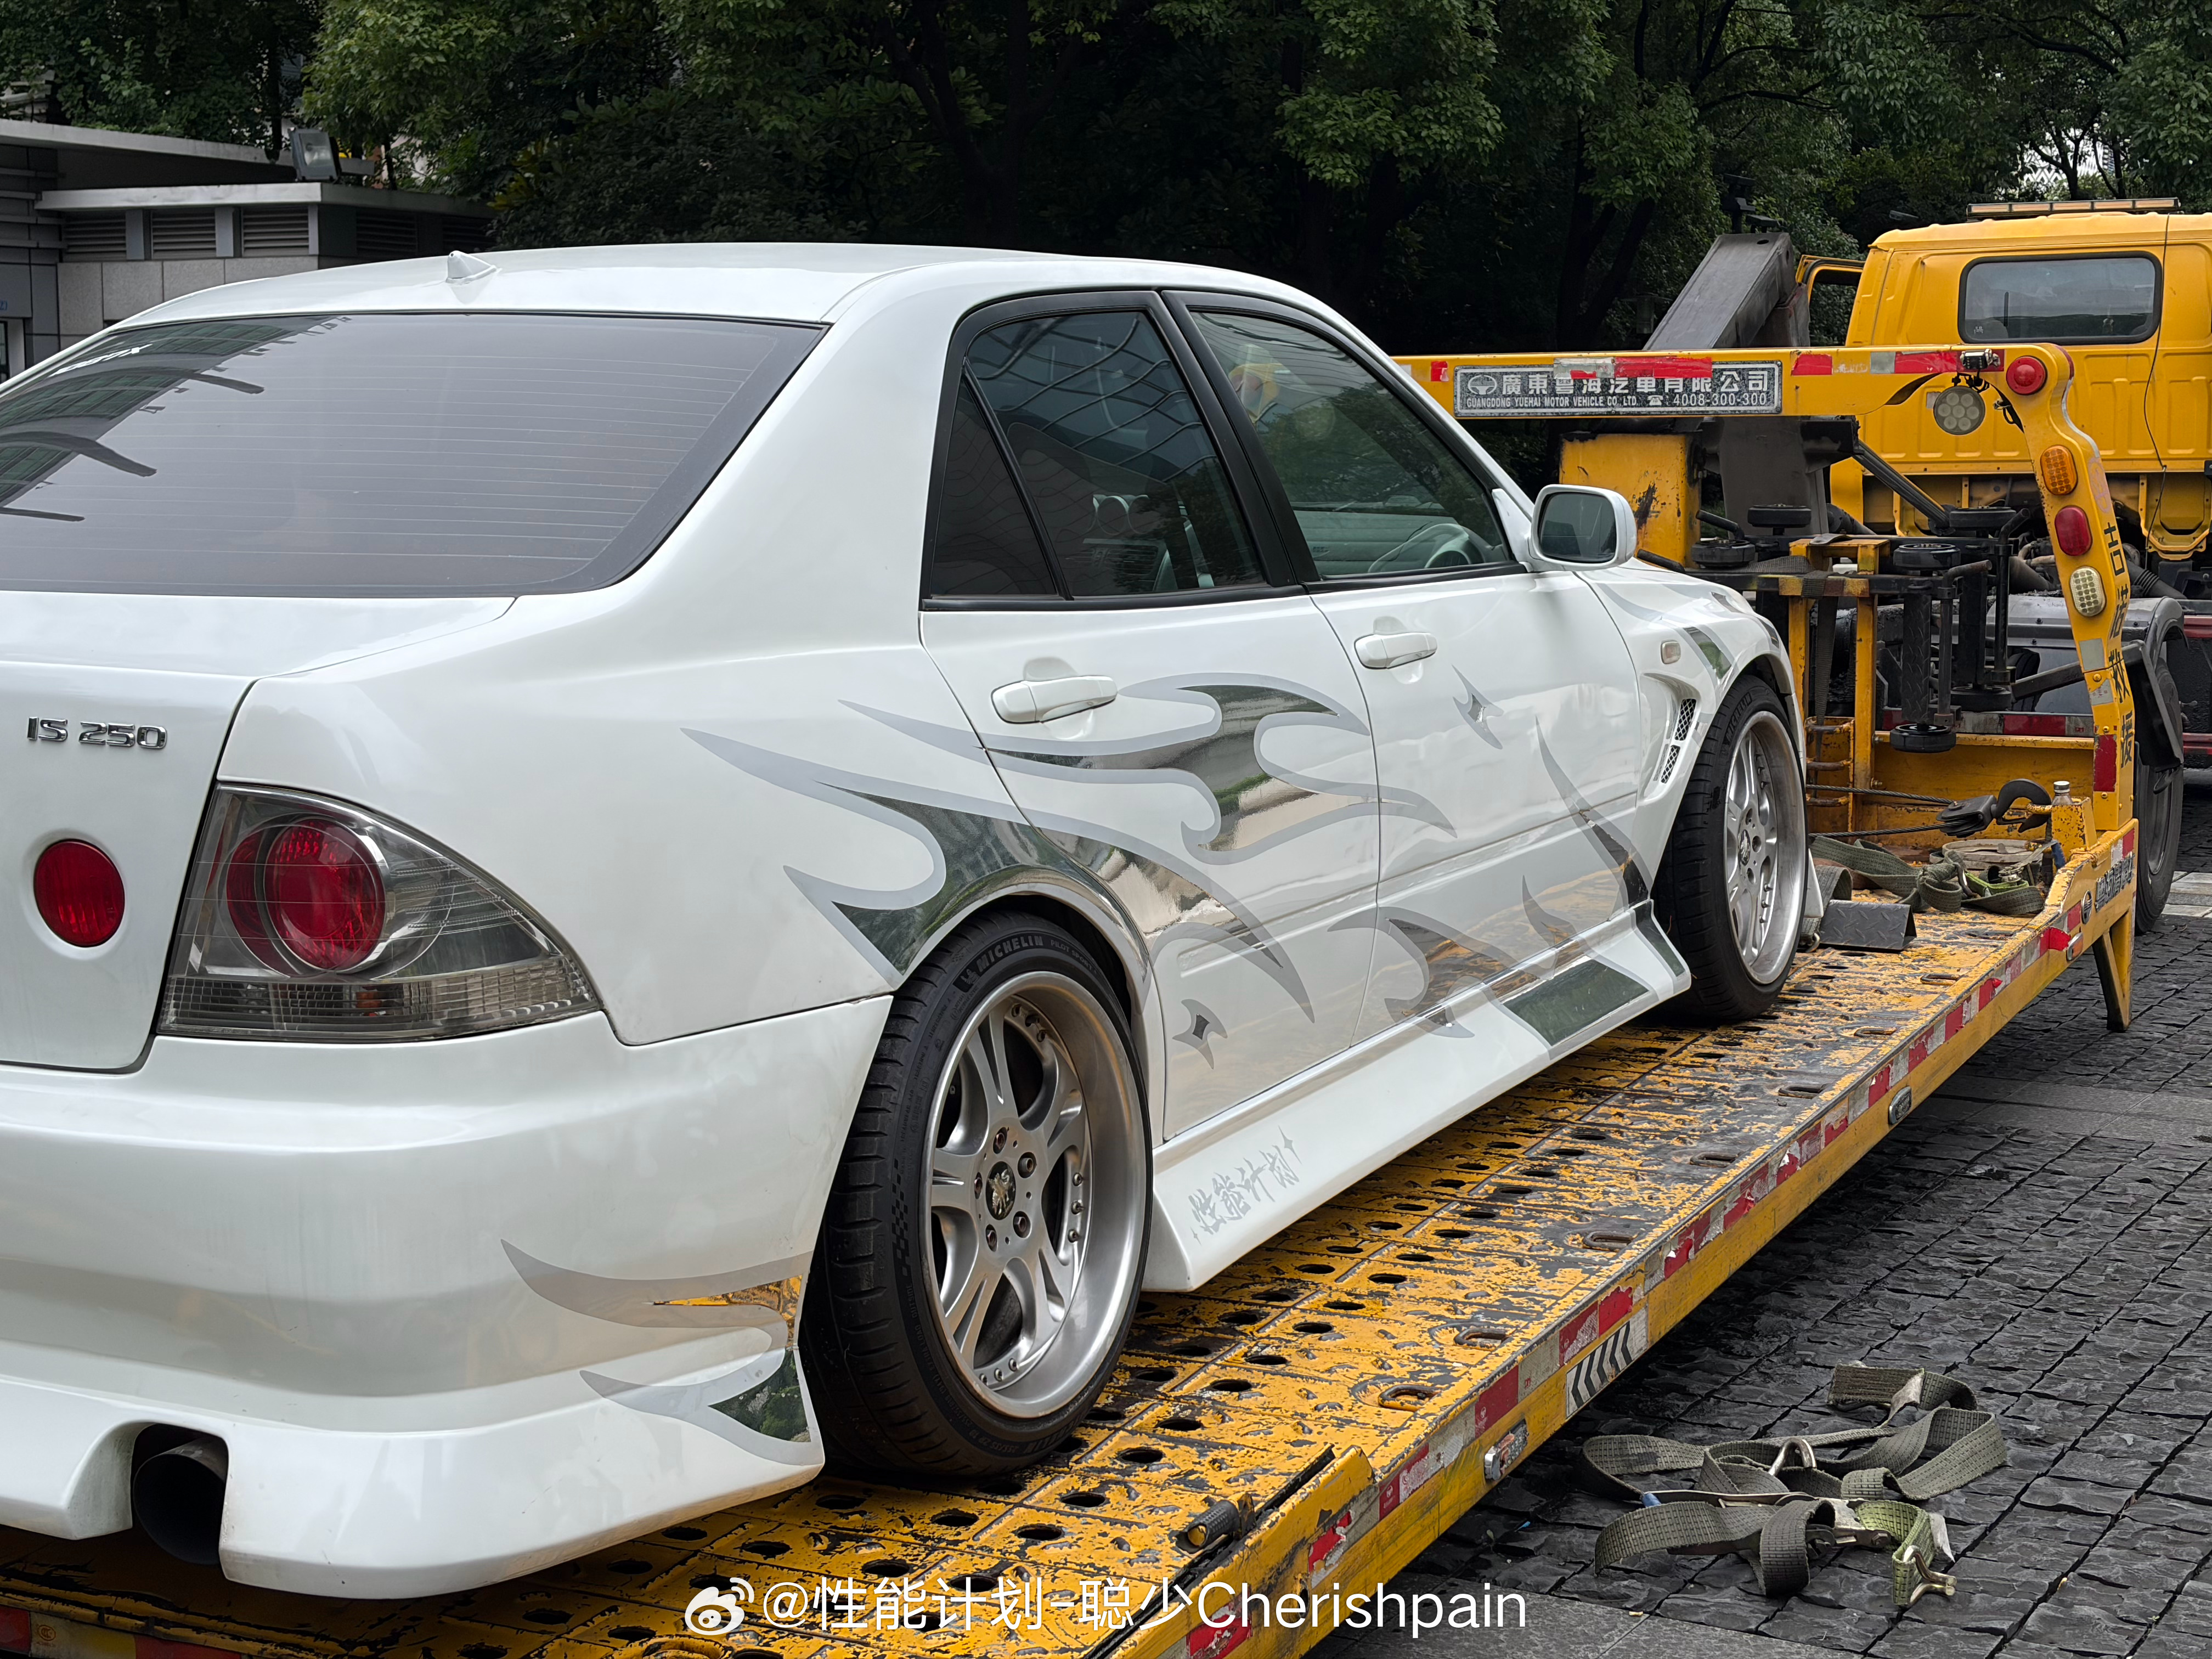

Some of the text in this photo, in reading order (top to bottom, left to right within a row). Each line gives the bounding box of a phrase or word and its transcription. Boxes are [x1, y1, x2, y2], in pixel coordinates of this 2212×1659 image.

[1515, 397, 1541, 407] YUEHAI
[1544, 397, 1570, 407] MOTOR
[1573, 396, 1604, 407] VEHICLE
[1673, 393, 1766, 406] 4008-300-300
[27, 716, 167, 749] IS 250
[977, 935, 1093, 973] MICHELIN PILOT SPORT
